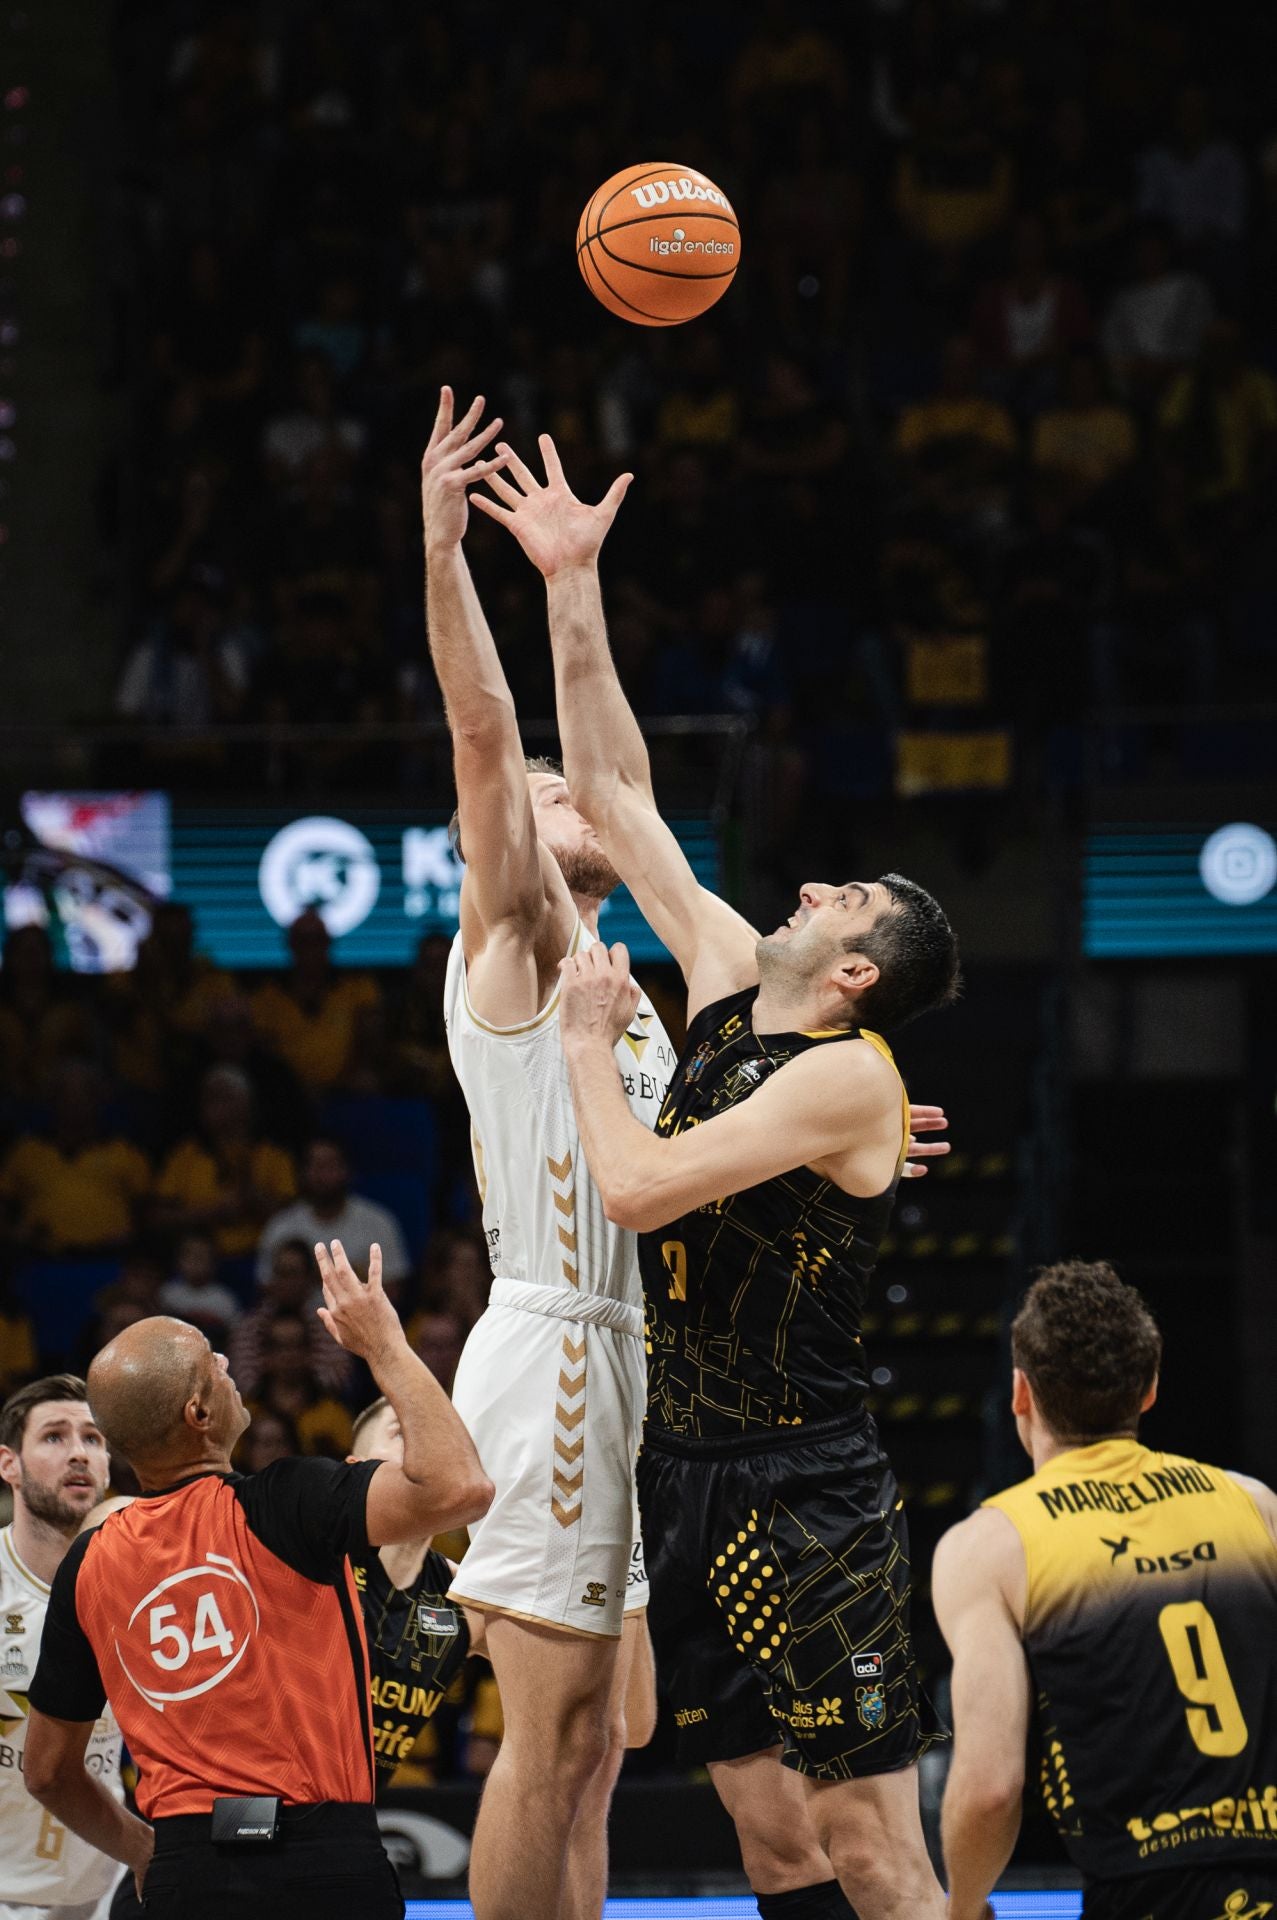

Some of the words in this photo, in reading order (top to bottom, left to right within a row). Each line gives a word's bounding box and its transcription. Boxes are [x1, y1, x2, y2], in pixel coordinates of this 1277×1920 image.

[650, 237, 681, 255] liga
[684, 240, 734, 254] endesa
[149, 1592, 235, 1671] 54
[857, 1663, 877, 1674] acb
[1158, 1600, 1249, 1757] 9
